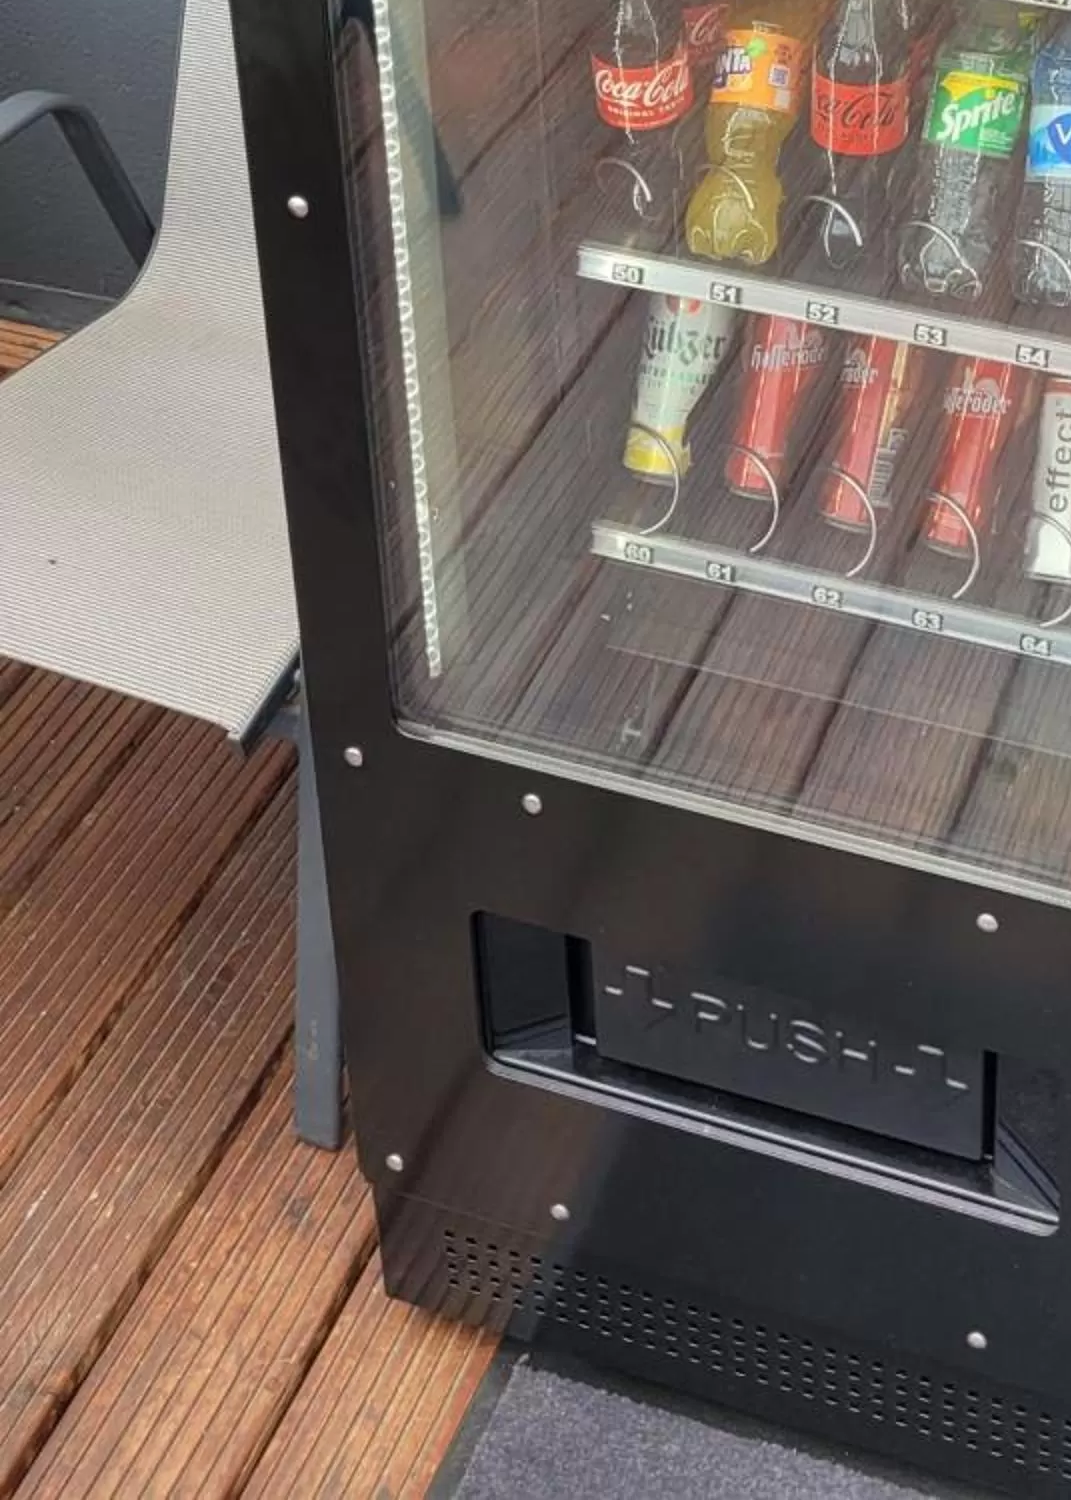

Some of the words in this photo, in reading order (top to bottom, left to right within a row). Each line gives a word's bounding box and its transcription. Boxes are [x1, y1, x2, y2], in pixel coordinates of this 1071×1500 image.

[936, 88, 1016, 143] Sprite
[612, 265, 639, 282] 50
[711, 285, 737, 302] 51
[808, 303, 836, 322] 52
[915, 327, 943, 344] 53
[1017, 346, 1047, 365] 54
[625, 543, 651, 562] 60
[707, 561, 733, 581] 61
[813, 588, 841, 608] 62
[913, 612, 941, 629] 63
[1021, 637, 1050, 654] 64
[690, 991, 880, 1082] PUSH
